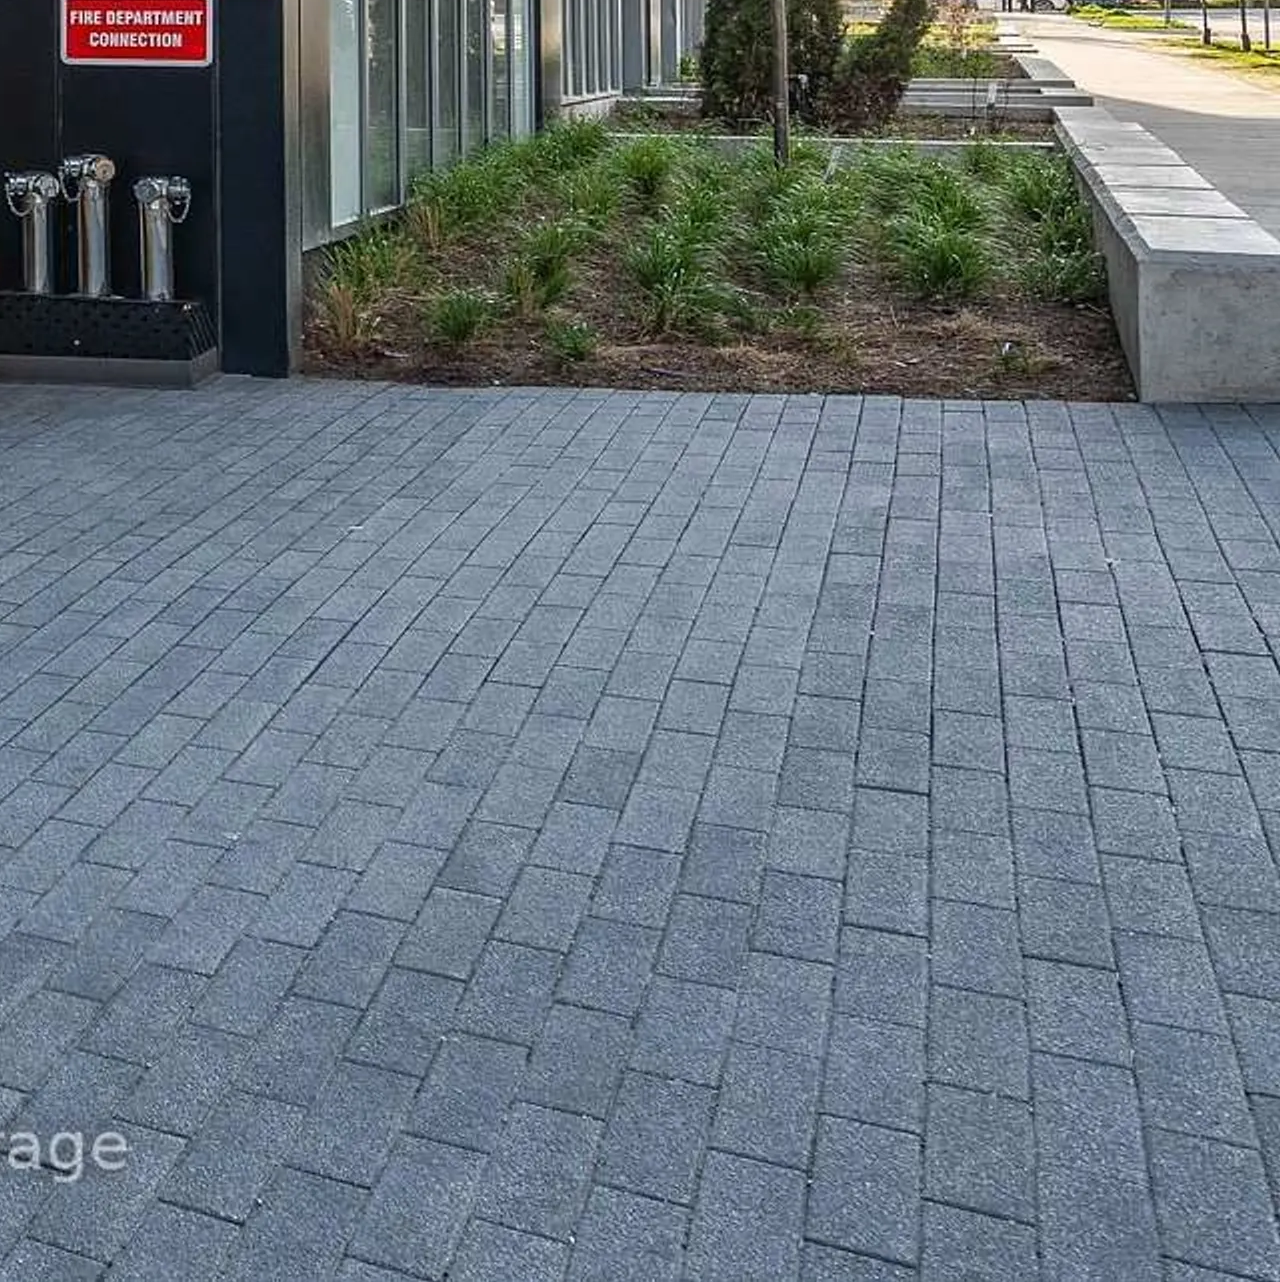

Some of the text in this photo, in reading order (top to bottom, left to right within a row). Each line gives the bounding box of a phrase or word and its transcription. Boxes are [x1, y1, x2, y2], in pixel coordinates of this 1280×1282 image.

[69, 10, 203, 25] FIRE DEPARTMENT
[89, 32, 182, 47] CONNECTION
